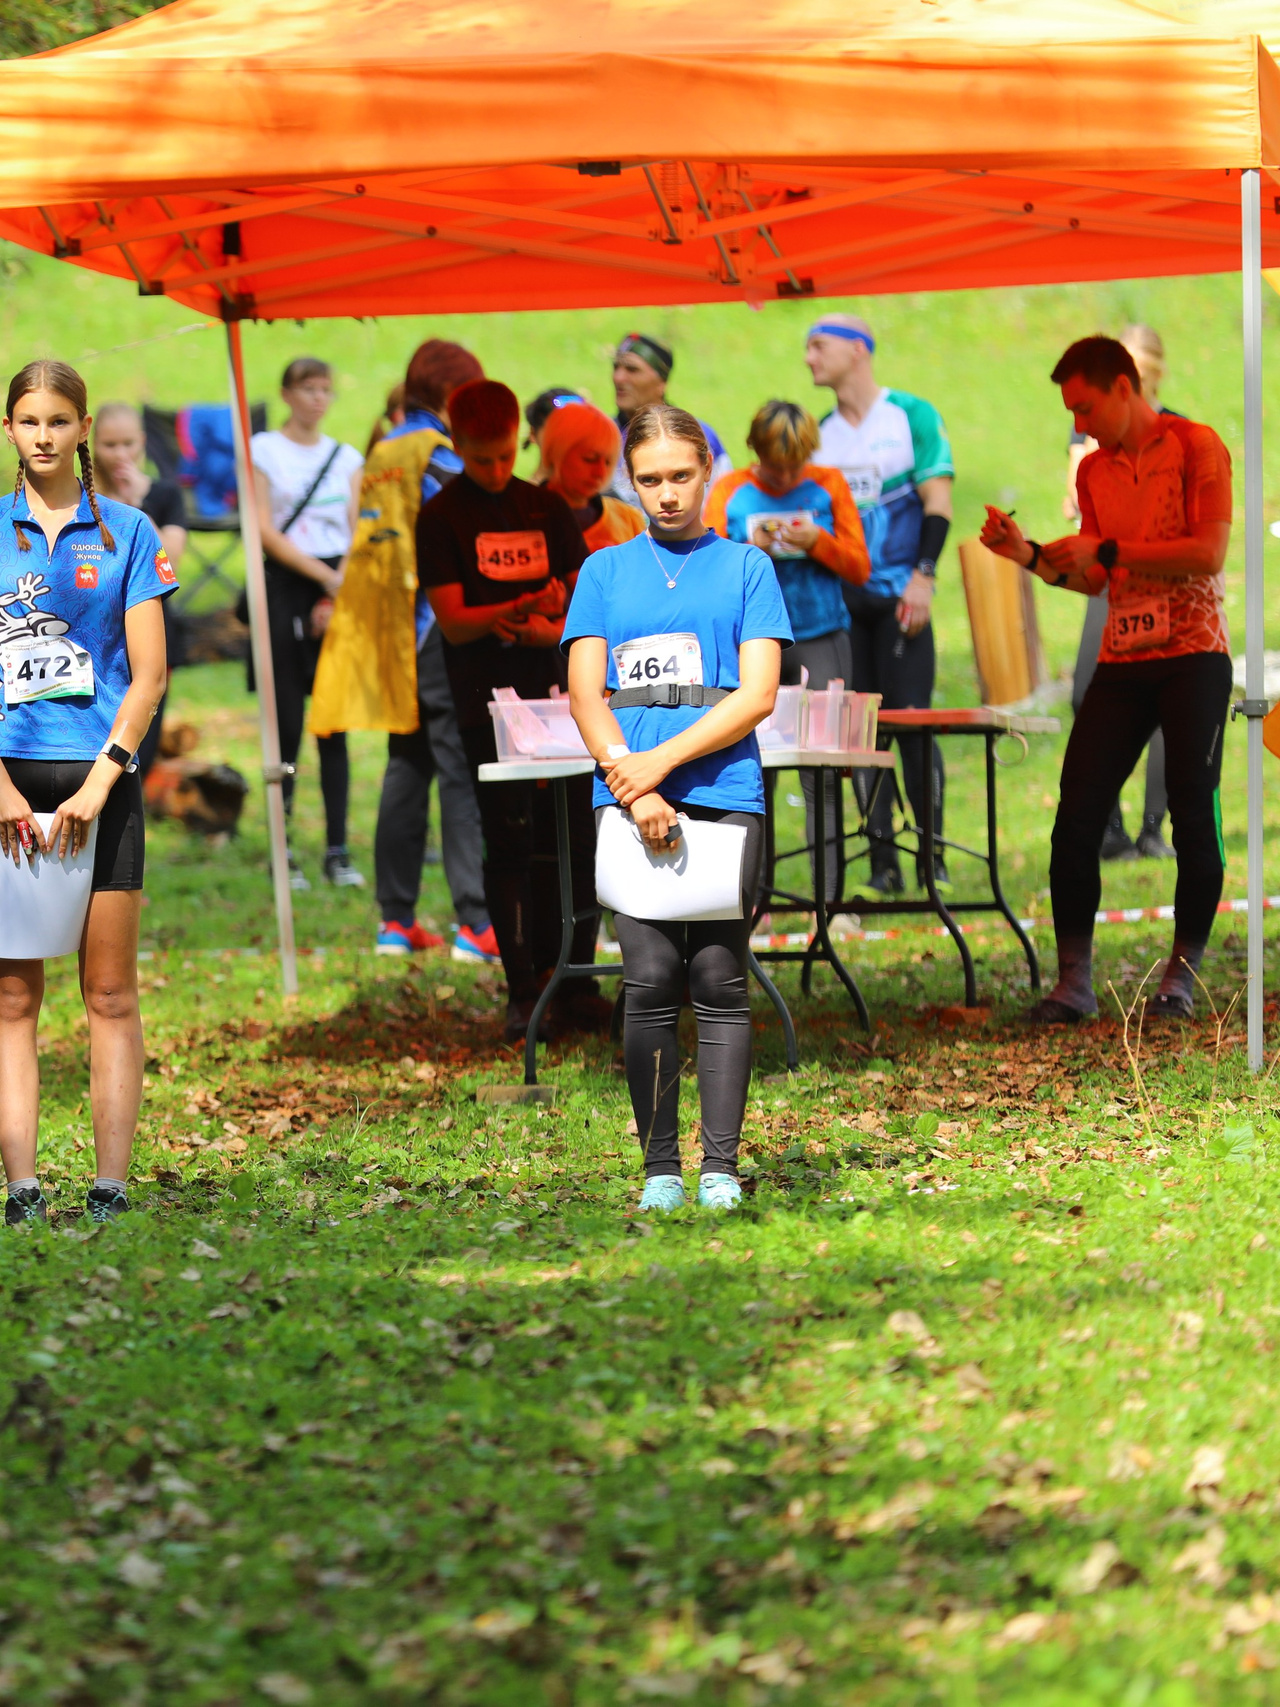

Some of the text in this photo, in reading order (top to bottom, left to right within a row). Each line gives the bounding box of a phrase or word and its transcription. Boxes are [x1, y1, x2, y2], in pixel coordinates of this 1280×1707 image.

[71, 544, 105, 552] ОДЮСШ
[488, 549, 531, 567] 455
[1118, 613, 1155, 635] 379
[17, 655, 72, 681] 472
[628, 655, 681, 681] 464
